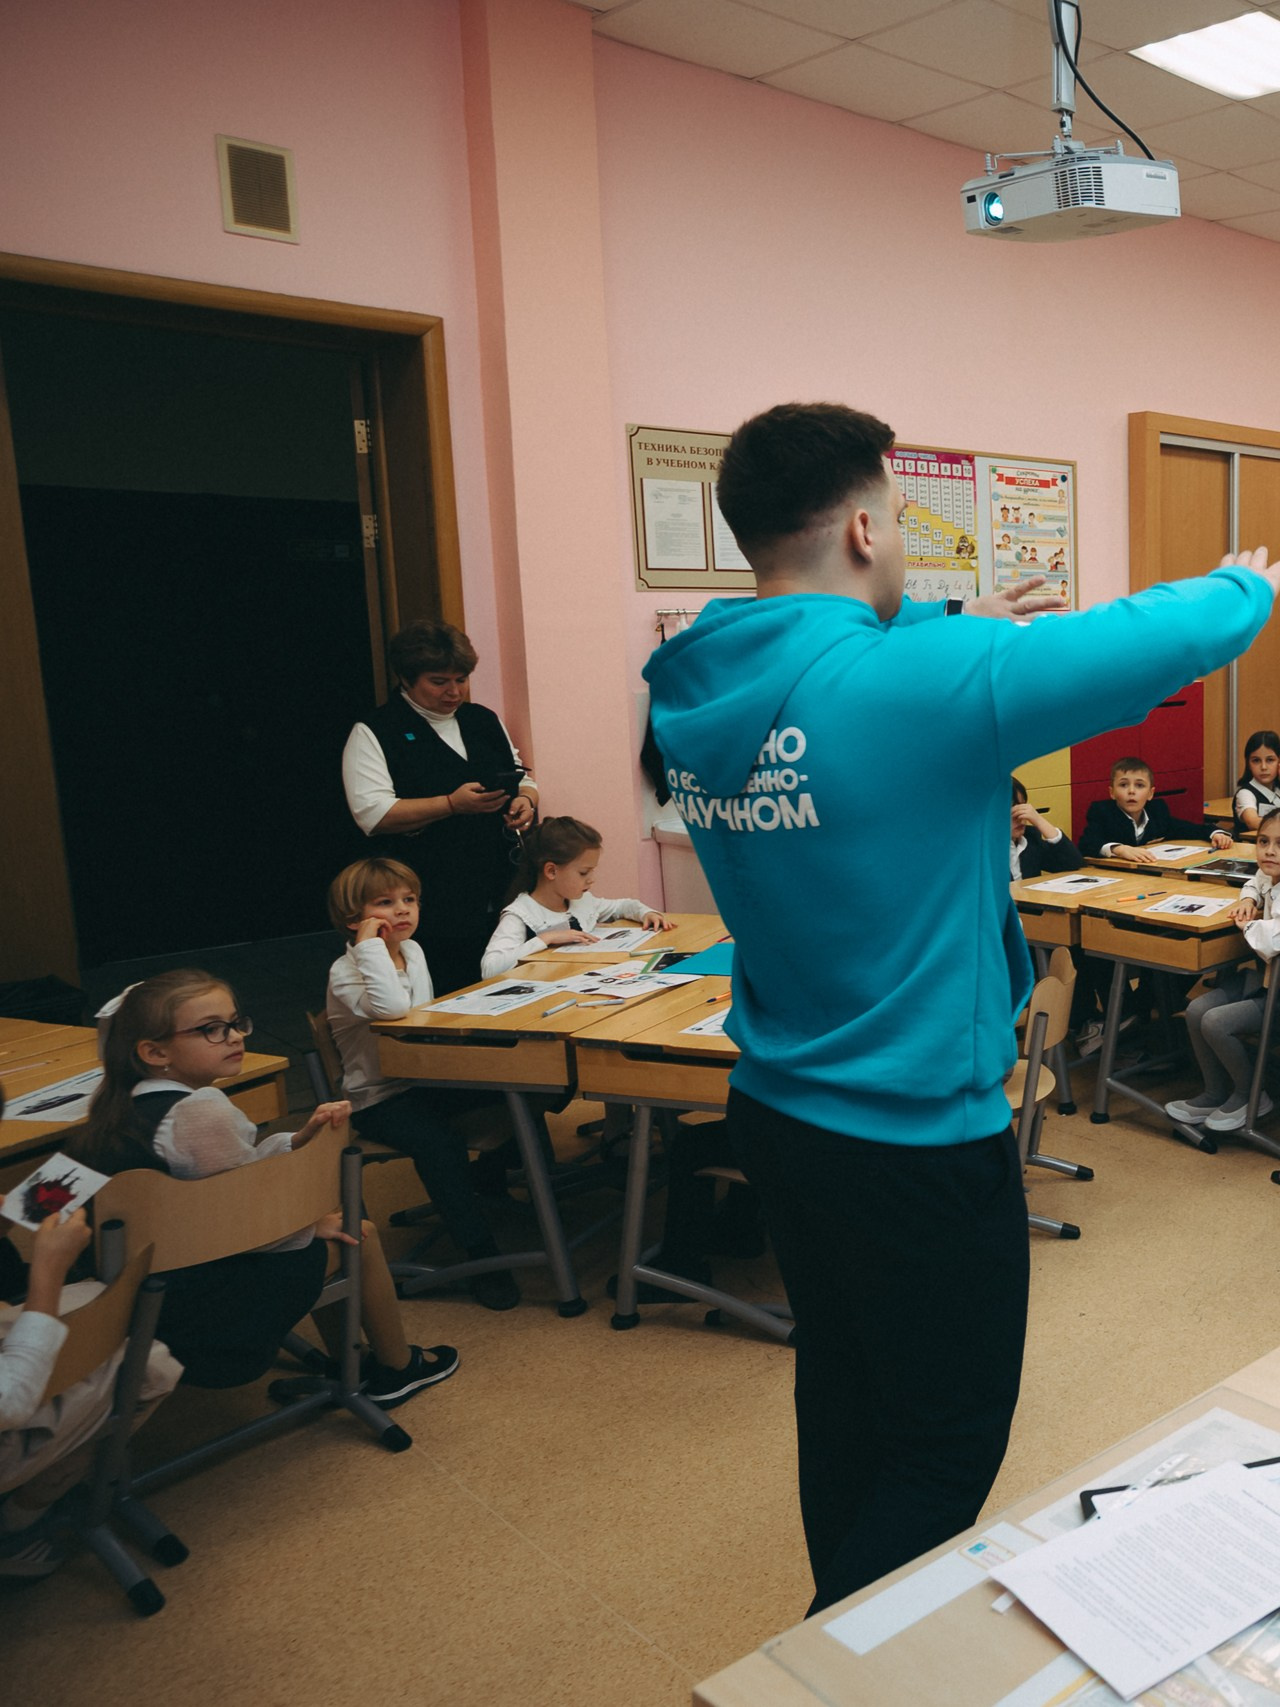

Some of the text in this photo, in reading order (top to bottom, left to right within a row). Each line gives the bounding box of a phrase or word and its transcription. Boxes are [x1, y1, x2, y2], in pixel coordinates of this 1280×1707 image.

[637, 441, 722, 458] ТЕХНИКА БЕЗОП
[646, 457, 653, 466] В
[656, 458, 706, 470] УЧЕБНОМ
[1015, 478, 1040, 487] УСПЕХА
[909, 518, 917, 526] 15
[934, 531, 941, 539] 17
[667, 768, 679, 789] О
[671, 793, 821, 832] НАУЧНОМ
